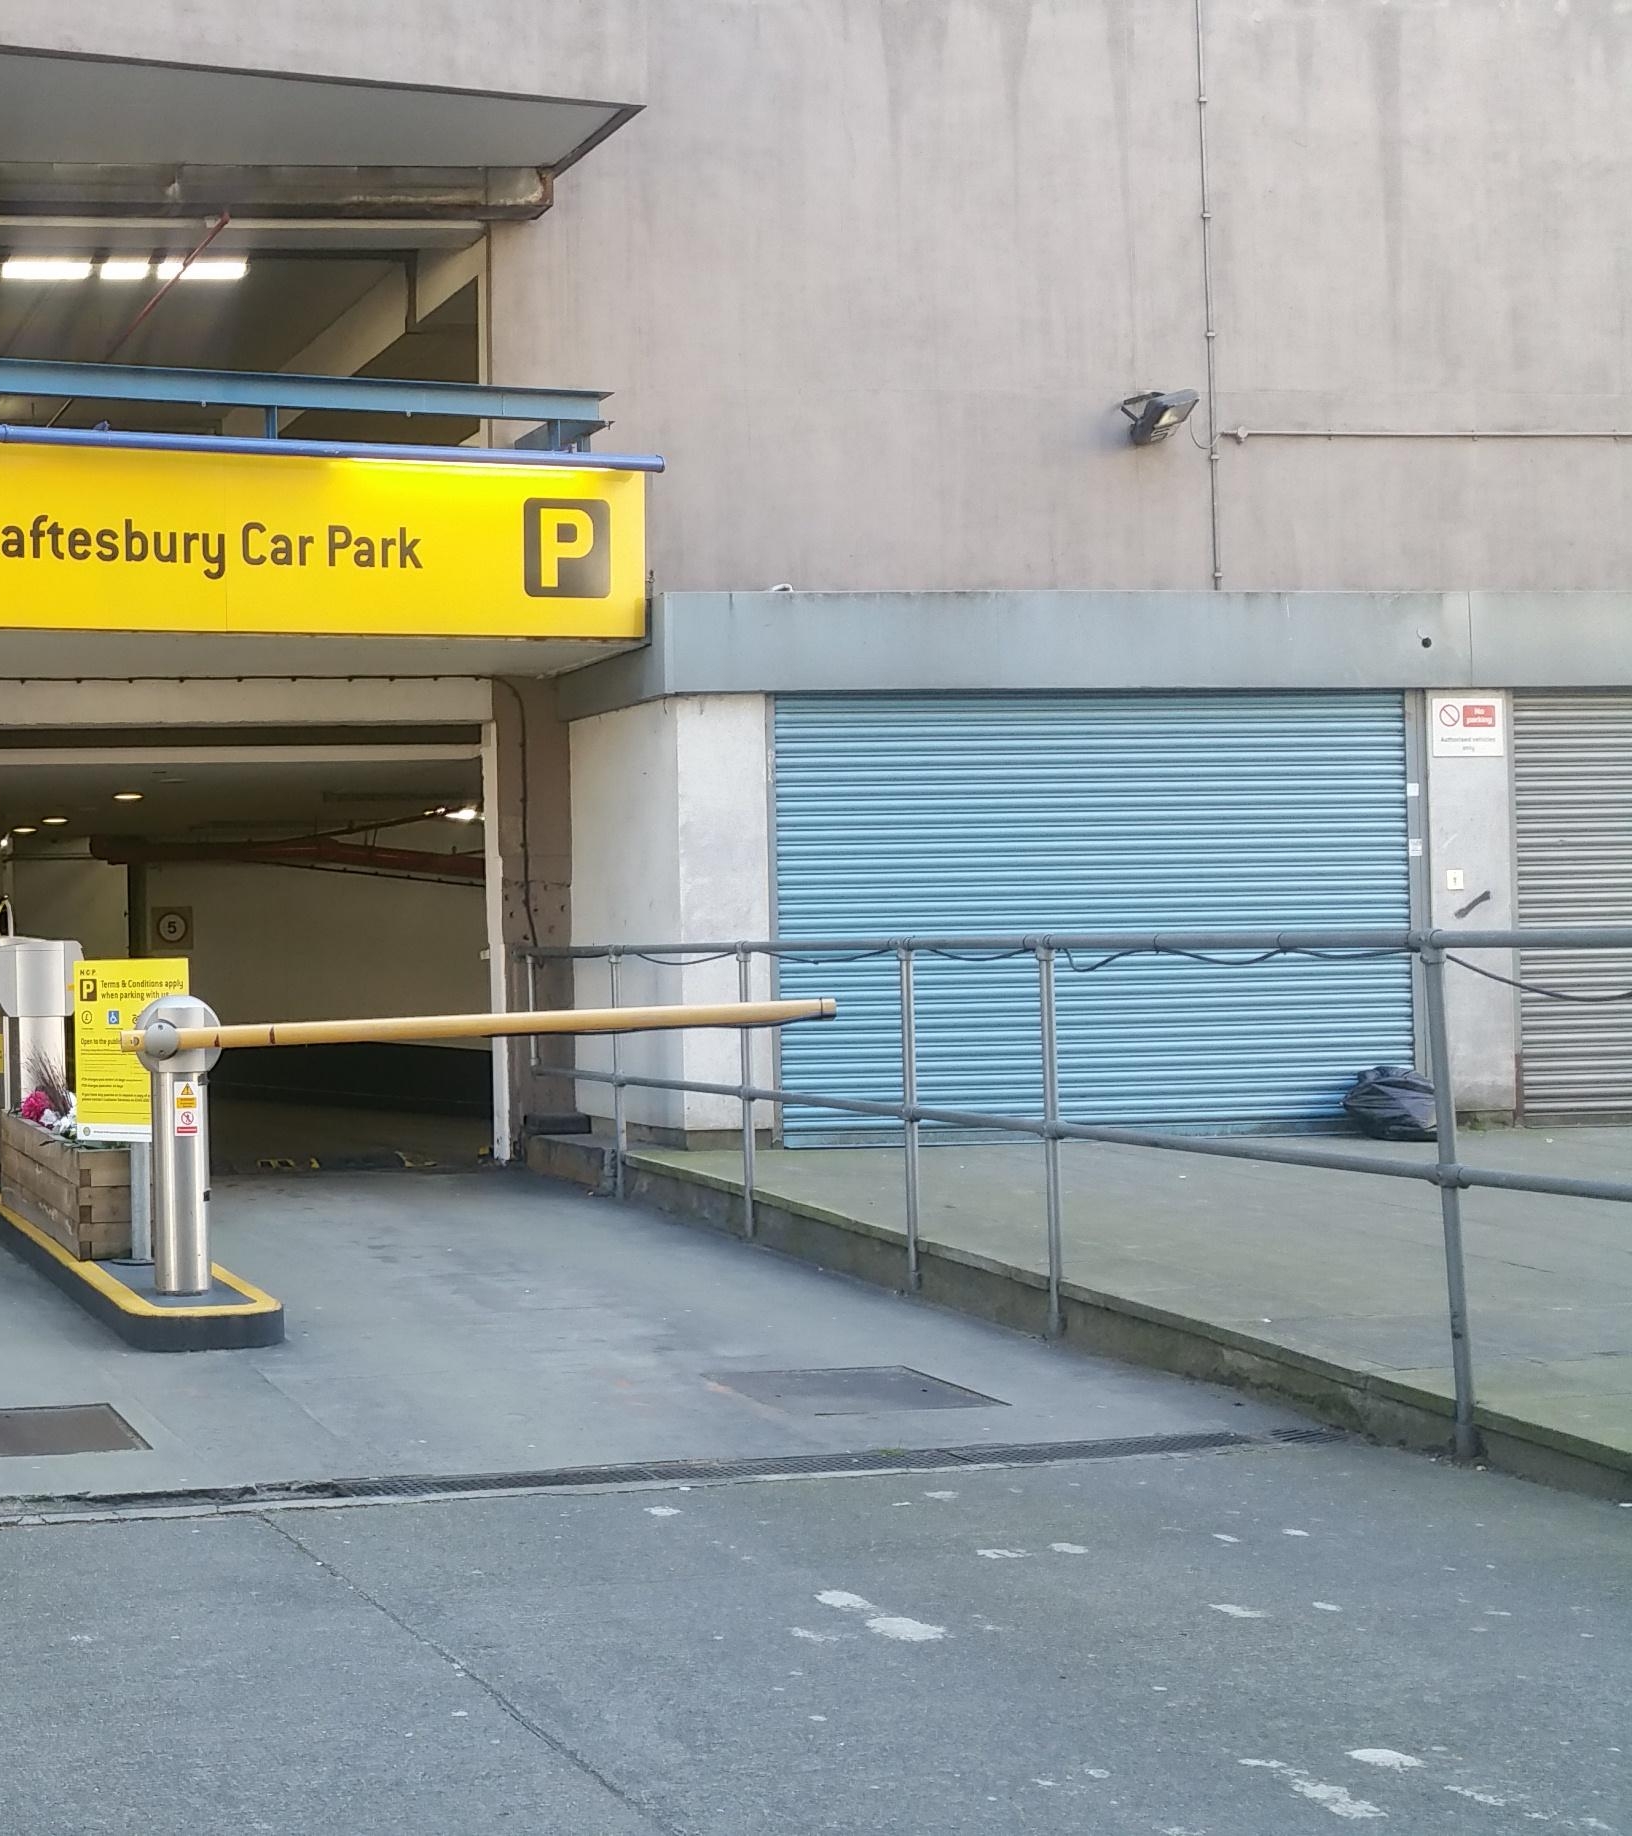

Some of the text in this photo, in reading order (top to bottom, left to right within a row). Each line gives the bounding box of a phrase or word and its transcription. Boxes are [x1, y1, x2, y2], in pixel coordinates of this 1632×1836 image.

[241, 522, 314, 566] Car
[328, 527, 423, 570] Park
[540, 507, 594, 588] P
[168, 920, 177, 934] 5
[101, 979, 184, 989] Terms & Conditions apply
[101, 991, 119, 999] when
[120, 991, 145, 1001] parking
[80, 1037, 93, 1046] Open
